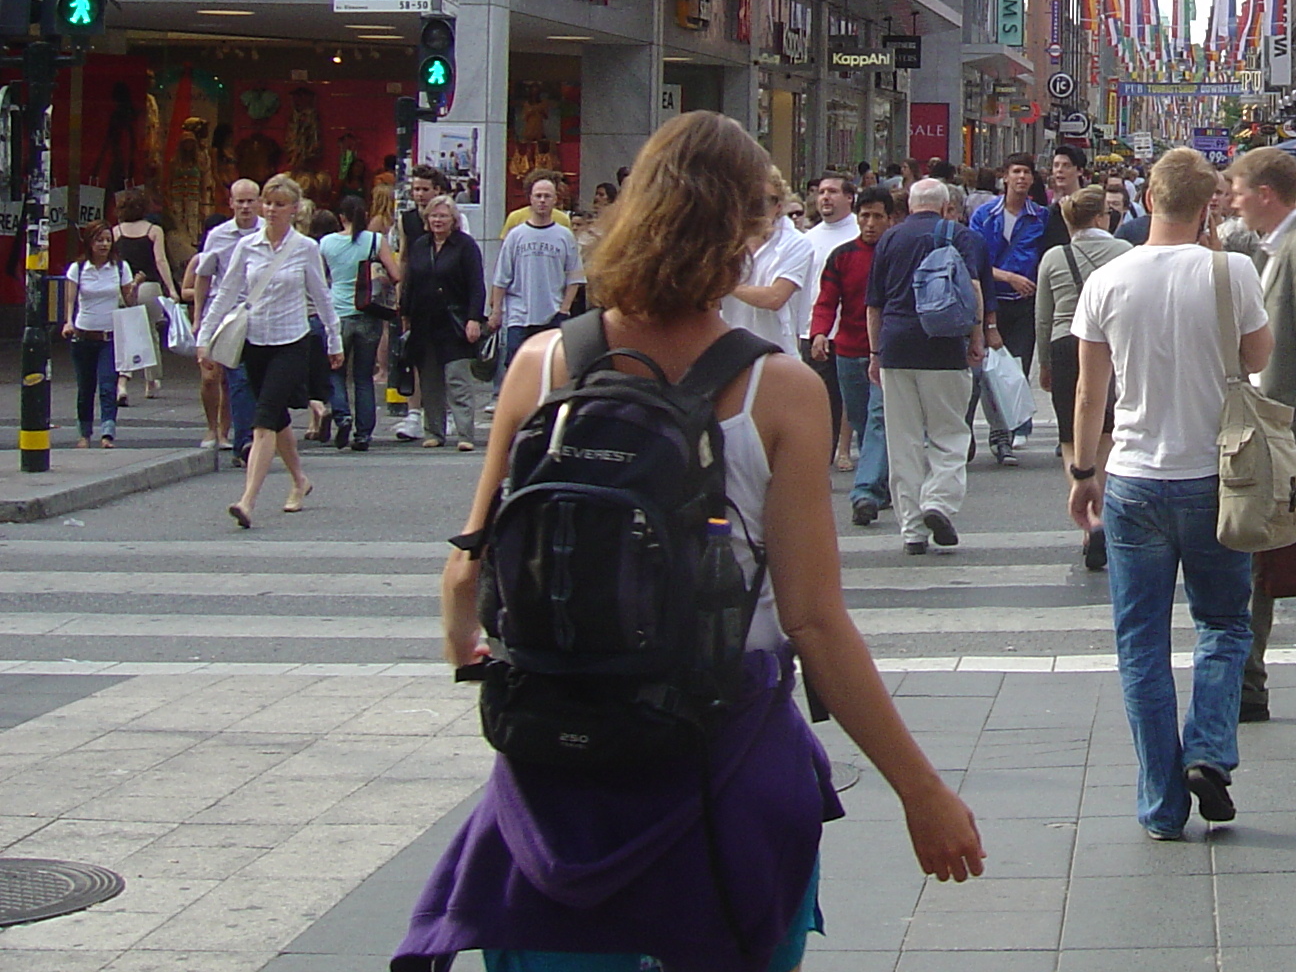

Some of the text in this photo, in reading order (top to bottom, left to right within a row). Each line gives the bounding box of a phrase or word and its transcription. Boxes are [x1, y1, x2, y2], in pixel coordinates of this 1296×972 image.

[399, 0, 429, 10] 58-50
[832, 52, 890, 67] KappAhl
[562, 445, 637, 463] EVEREST
